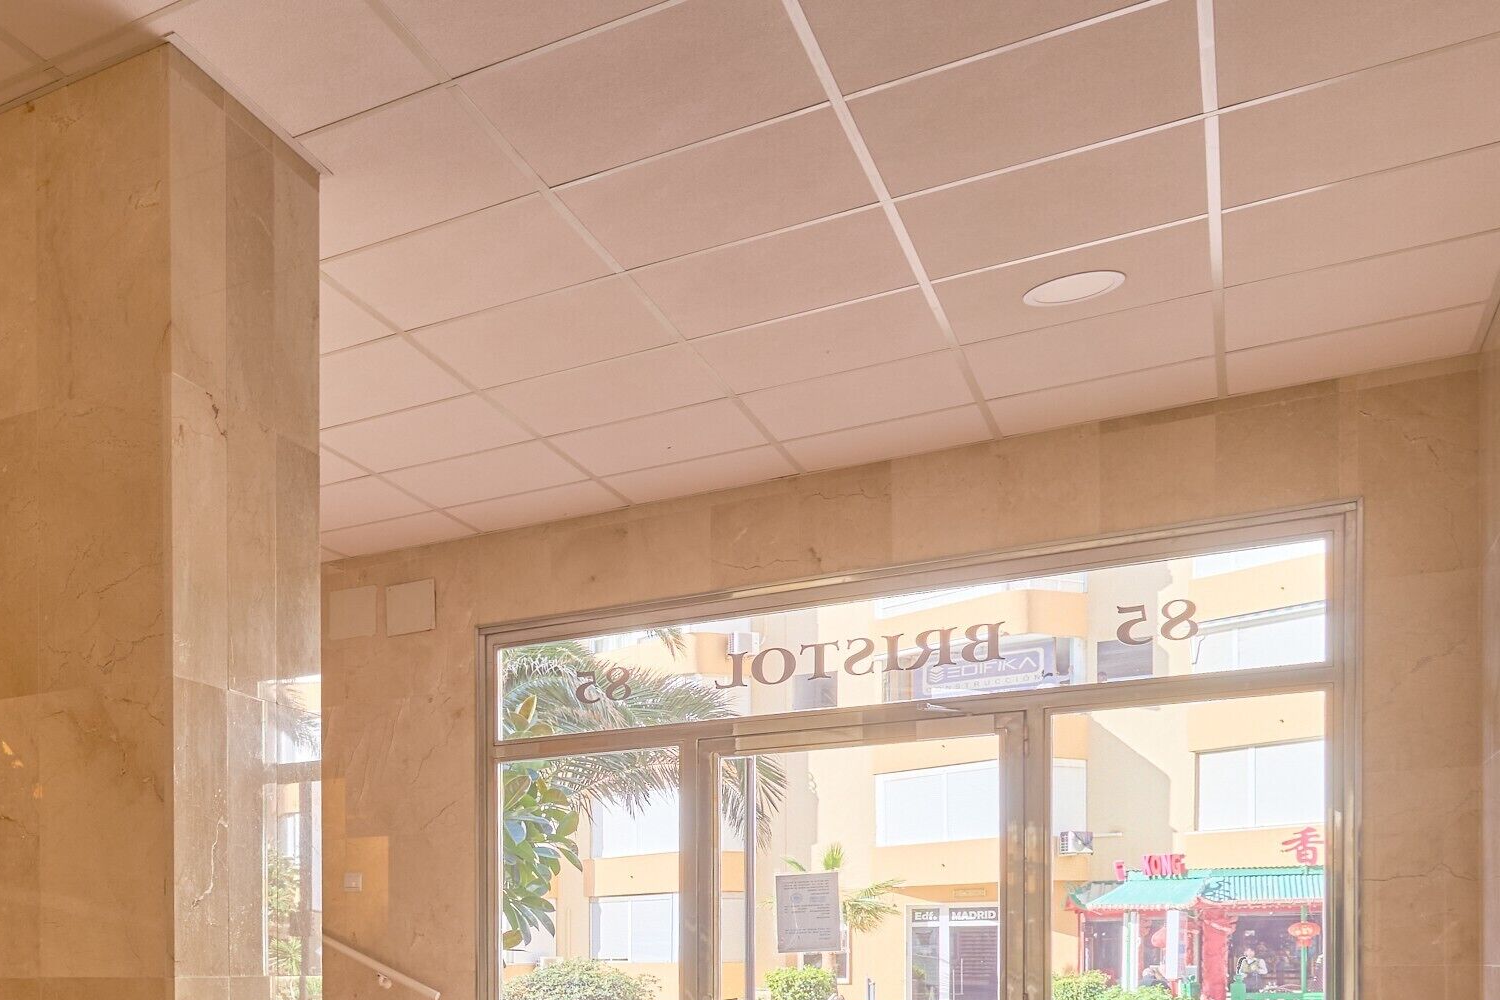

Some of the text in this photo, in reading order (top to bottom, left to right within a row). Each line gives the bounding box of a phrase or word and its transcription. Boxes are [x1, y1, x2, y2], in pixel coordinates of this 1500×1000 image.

[1282, 826, 1325, 866] 香
[914, 910, 997, 921] Edf. MADRID
